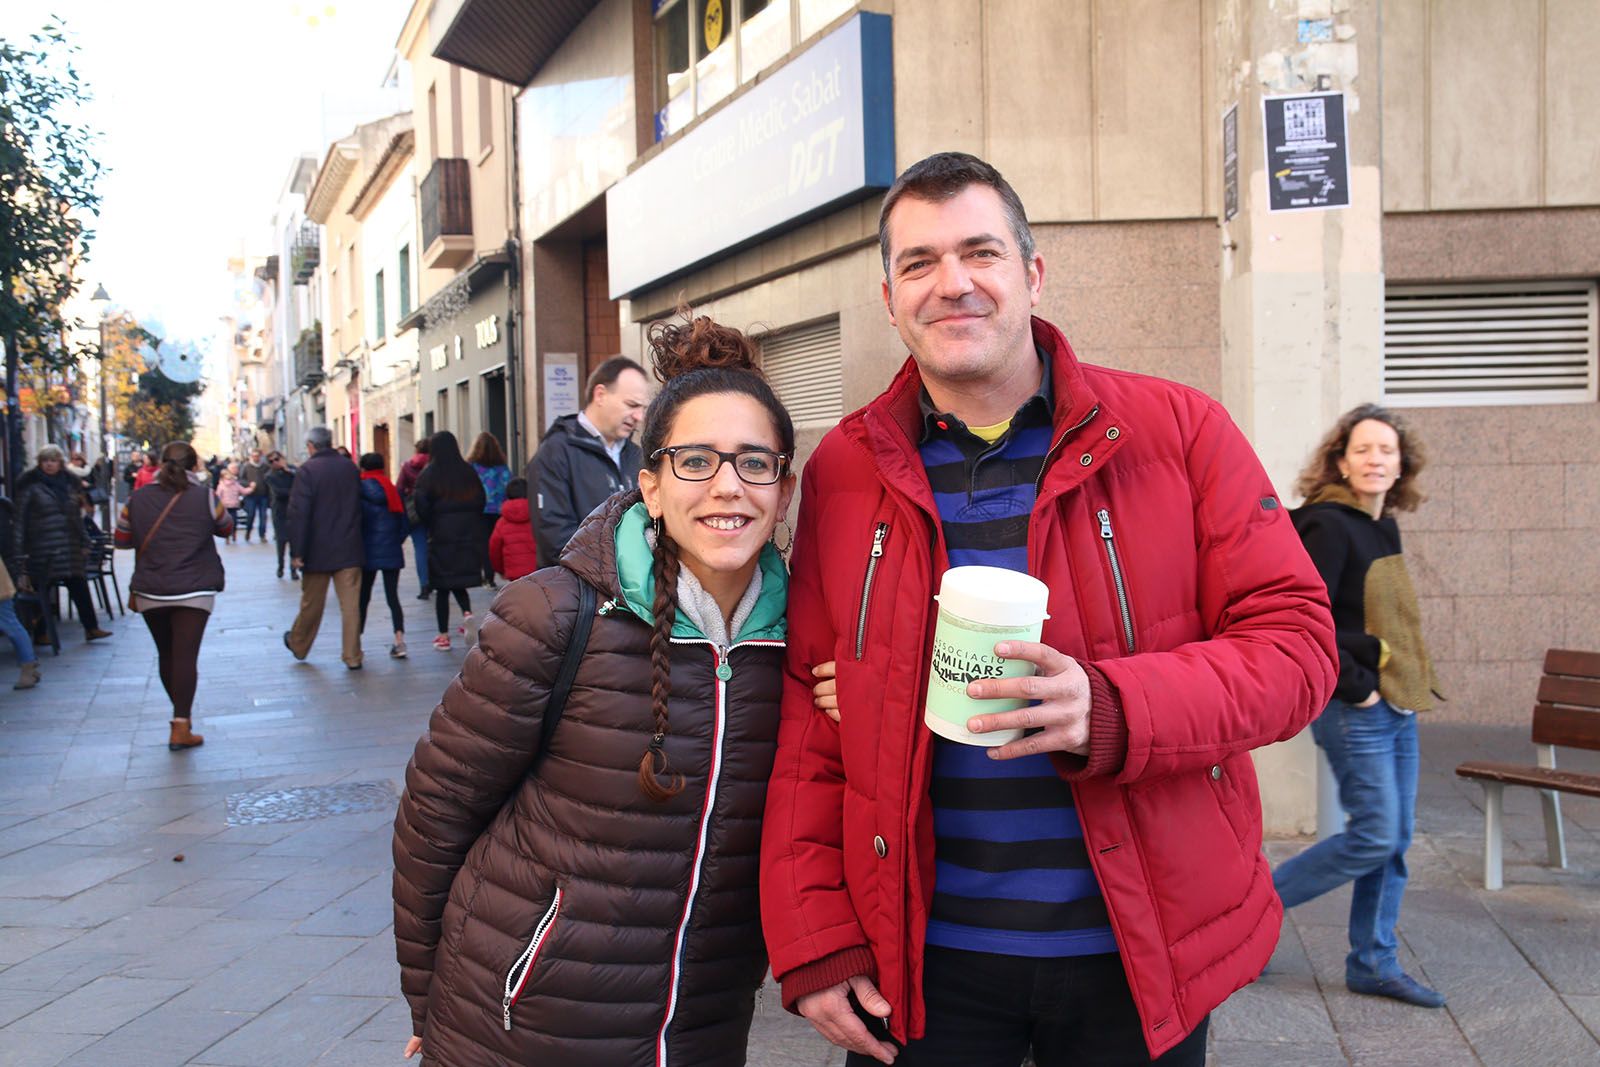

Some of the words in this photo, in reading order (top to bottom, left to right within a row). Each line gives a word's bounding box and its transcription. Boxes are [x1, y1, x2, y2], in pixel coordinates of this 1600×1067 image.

[792, 62, 841, 123] Sabat
[788, 117, 846, 194] DGT
[932, 659, 997, 683] ALZHEIM
[934, 645, 1003, 676] FAMILIARS
